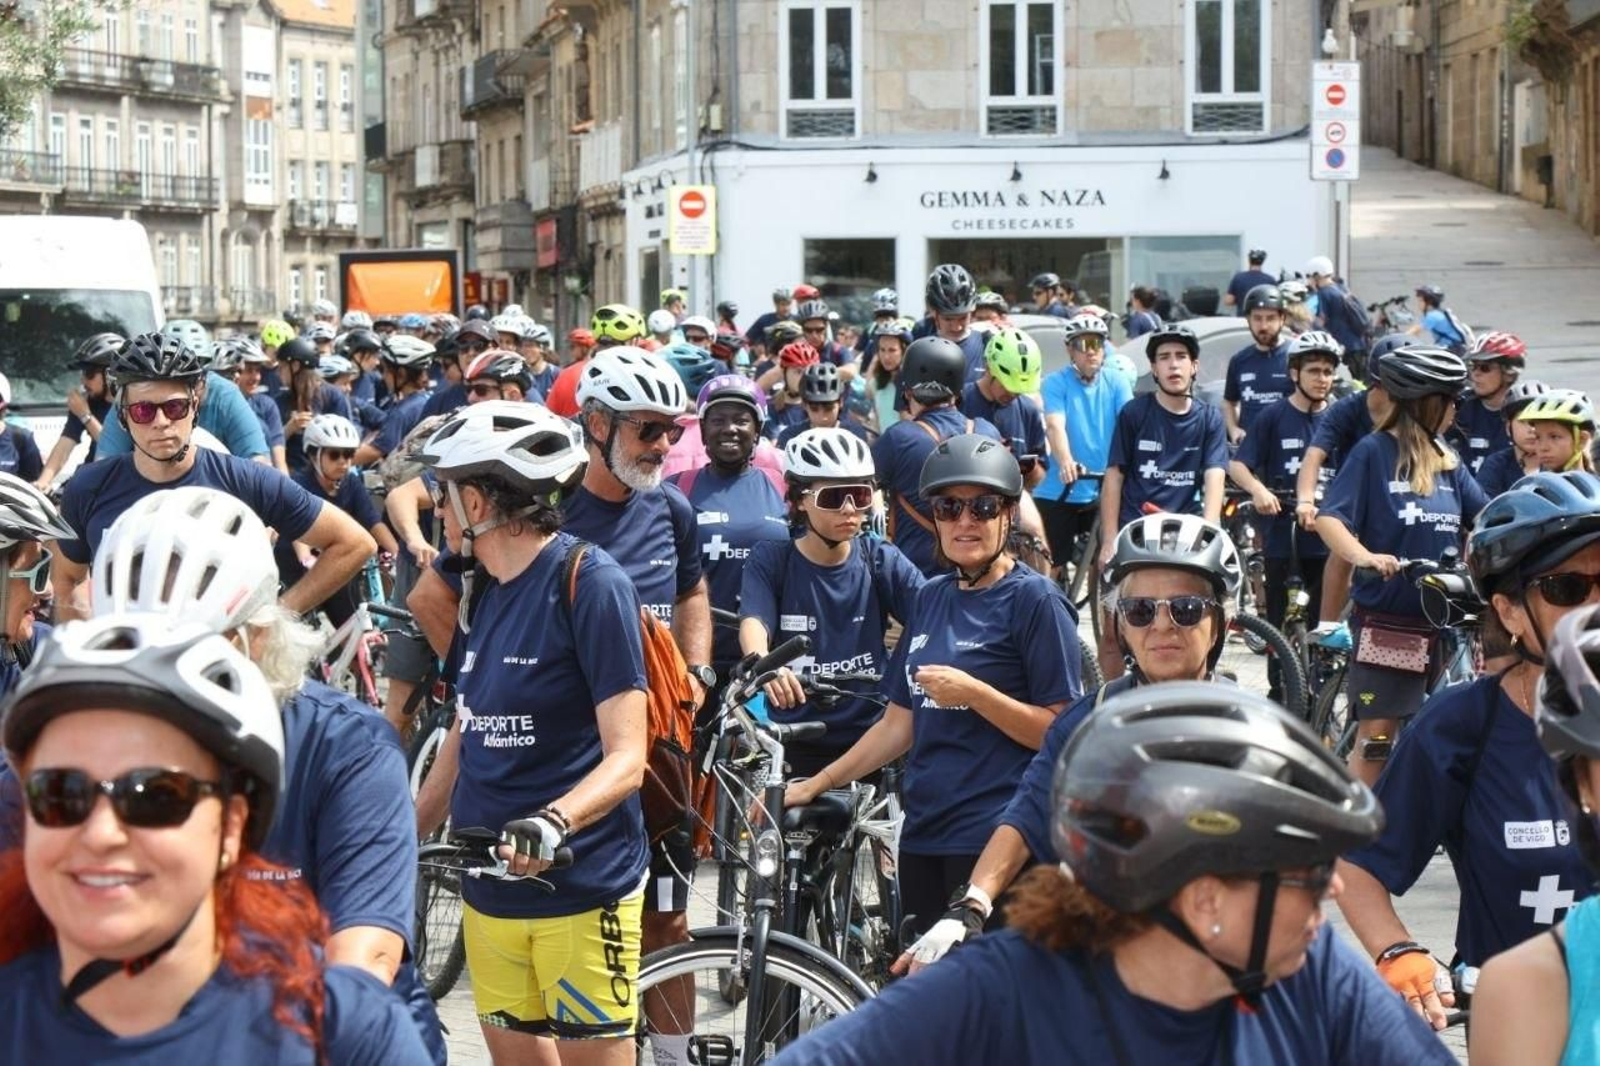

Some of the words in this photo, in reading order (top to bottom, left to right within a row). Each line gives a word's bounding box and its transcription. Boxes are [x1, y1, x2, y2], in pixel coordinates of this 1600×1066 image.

[920, 190, 1006, 209] GEMMA
[1016, 193, 1030, 208] &
[1040, 189, 1107, 208] NAZA
[951, 218, 1076, 231] CHEESECAKES
[811, 652, 874, 675] DEPORTE
[470, 714, 535, 732] DEPORTE
[483, 731, 536, 748] Atlántico
[1508, 826, 1550, 835] CONCELLO
[1513, 835, 1524, 843] DE
